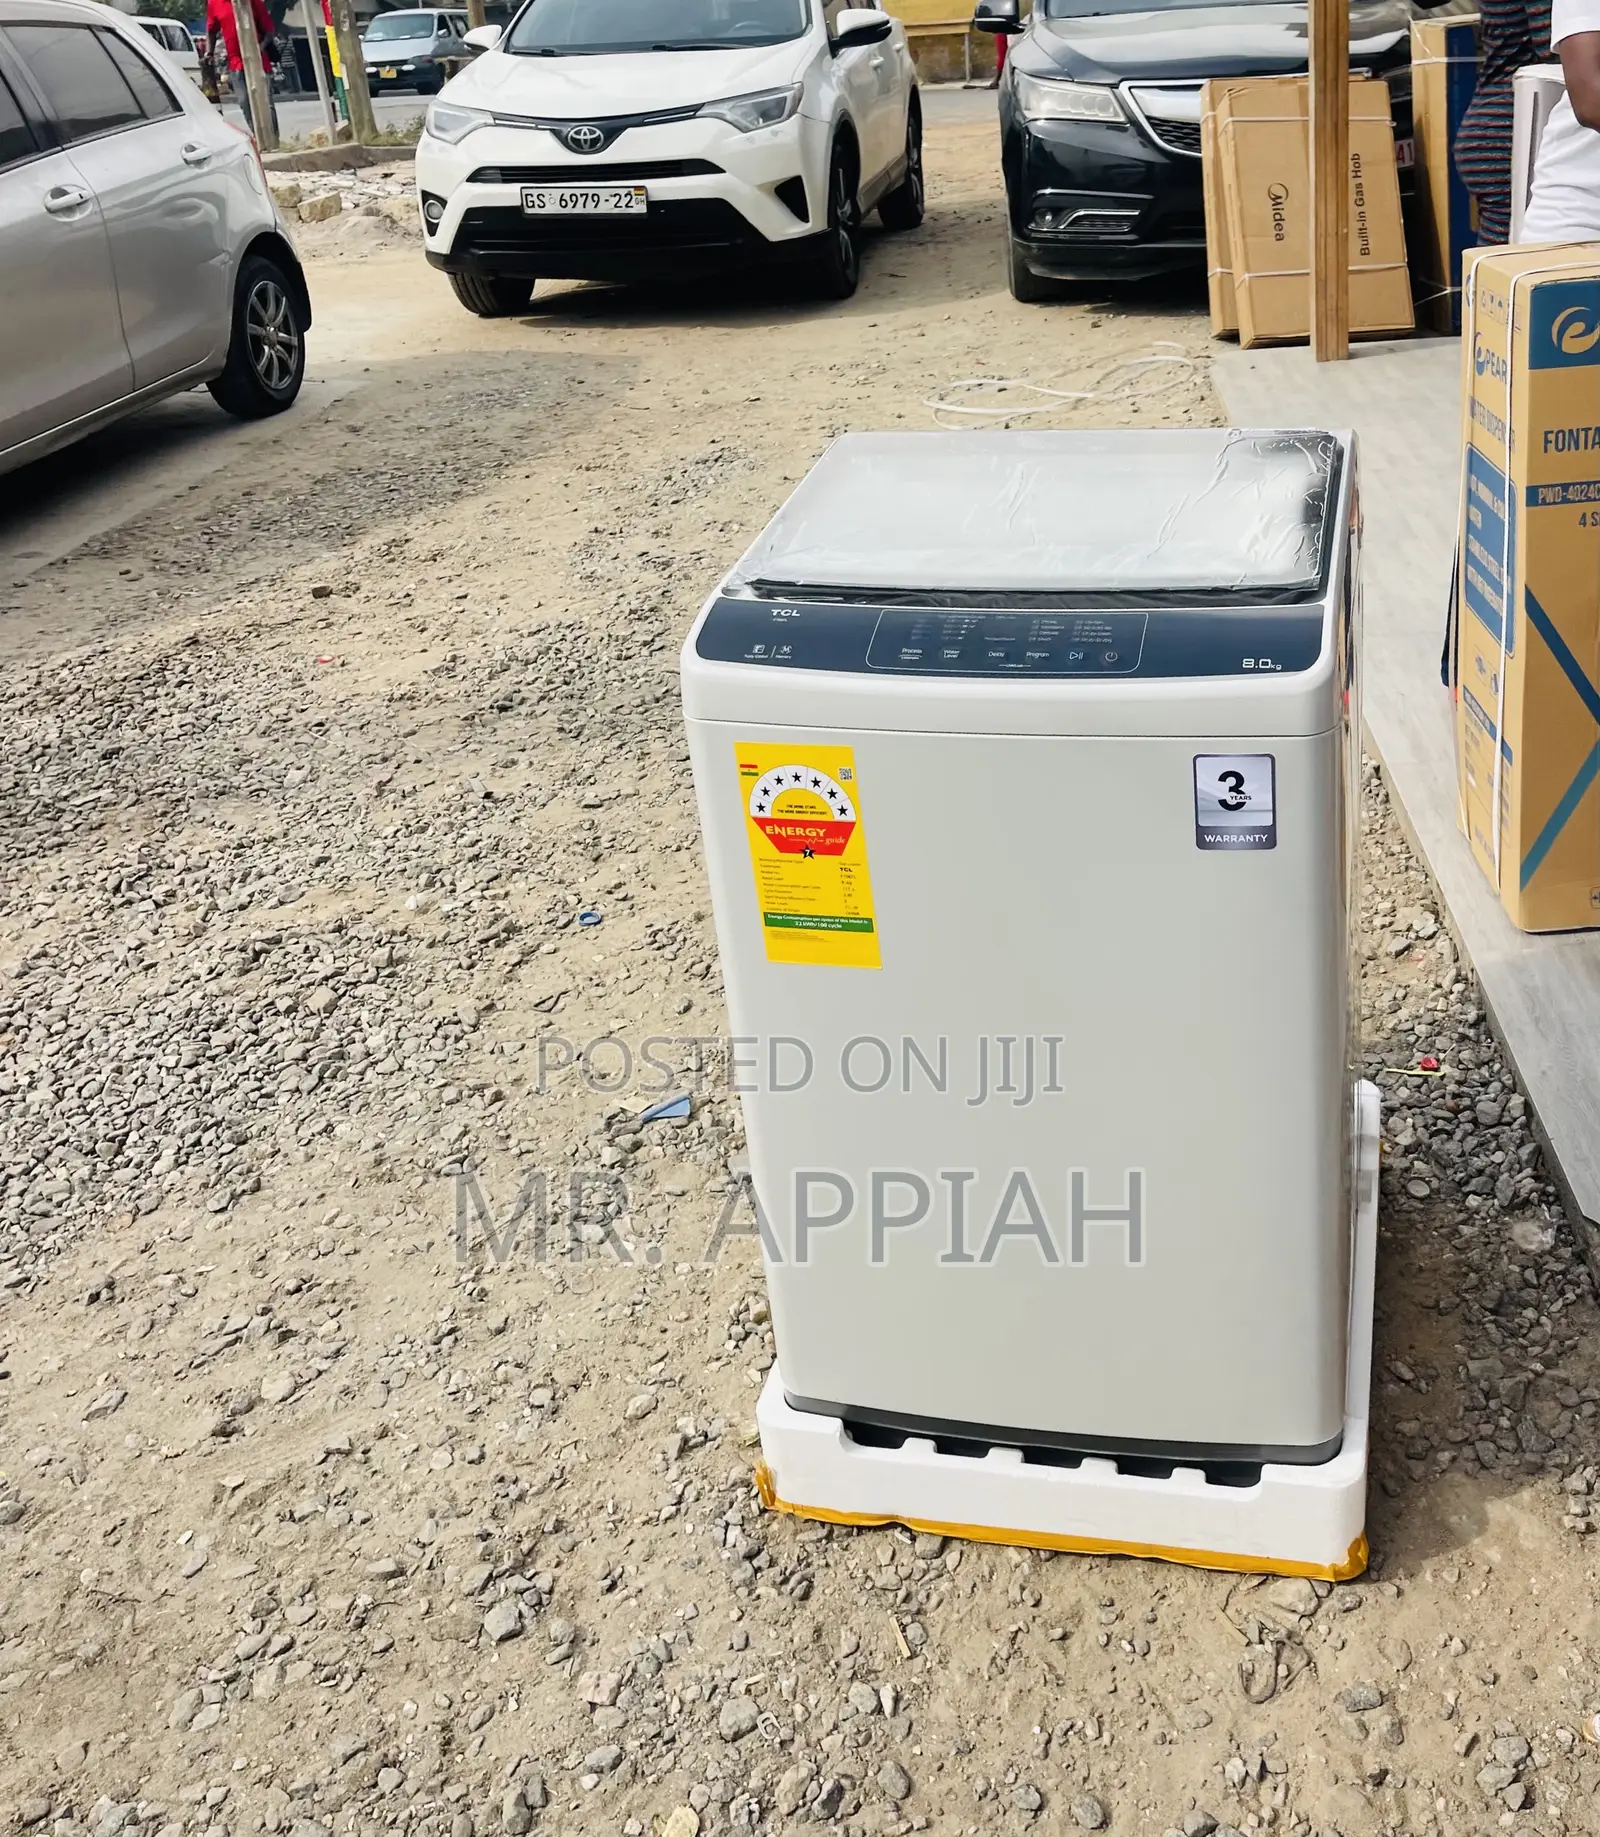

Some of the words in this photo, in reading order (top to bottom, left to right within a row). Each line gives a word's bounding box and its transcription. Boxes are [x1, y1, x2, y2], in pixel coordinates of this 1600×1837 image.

[1350, 152, 1362, 179] Hob
[524, 192, 546, 209] GS
[1354, 182, 1365, 208] Gas
[1268, 183, 1290, 242] Midea
[1485, 348, 1509, 385] PEAR
[1578, 511, 1587, 528] 4
[1591, 510, 1600, 527] S
[771, 609, 801, 617] TCL
[1217, 770, 1247, 812] 3
[765, 824, 827, 838] ENERGY
[1204, 834, 1268, 843] WARRANTY
[804, 849, 811, 857] 7
